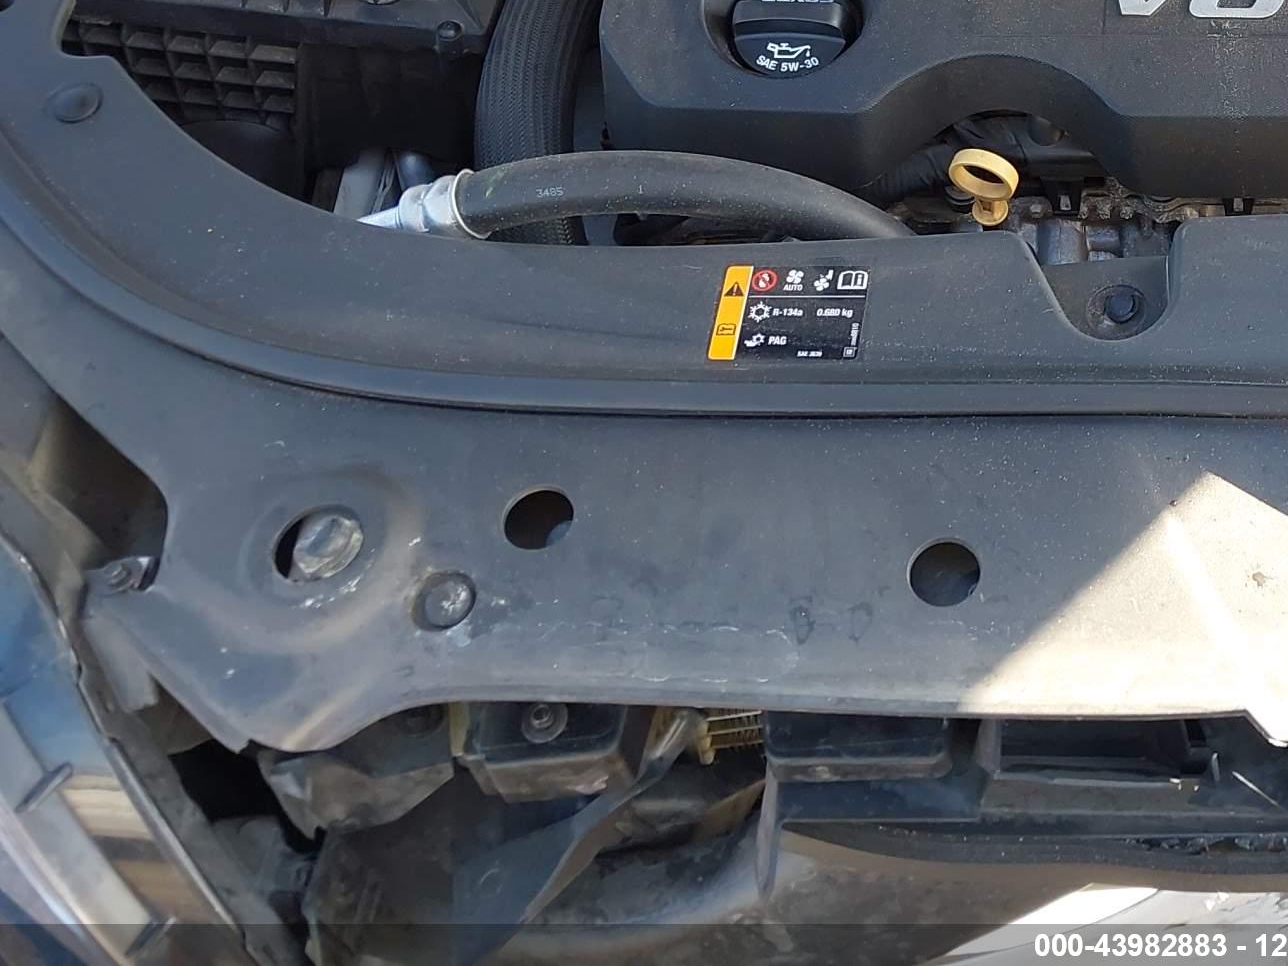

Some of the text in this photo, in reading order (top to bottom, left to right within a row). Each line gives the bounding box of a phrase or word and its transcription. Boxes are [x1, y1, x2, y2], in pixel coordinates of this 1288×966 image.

[756, 55, 819, 72] SAE 5W-30
[772, 308, 804, 317] R-134a
[841, 307, 854, 318] kg
[768, 336, 788, 345] PAG
